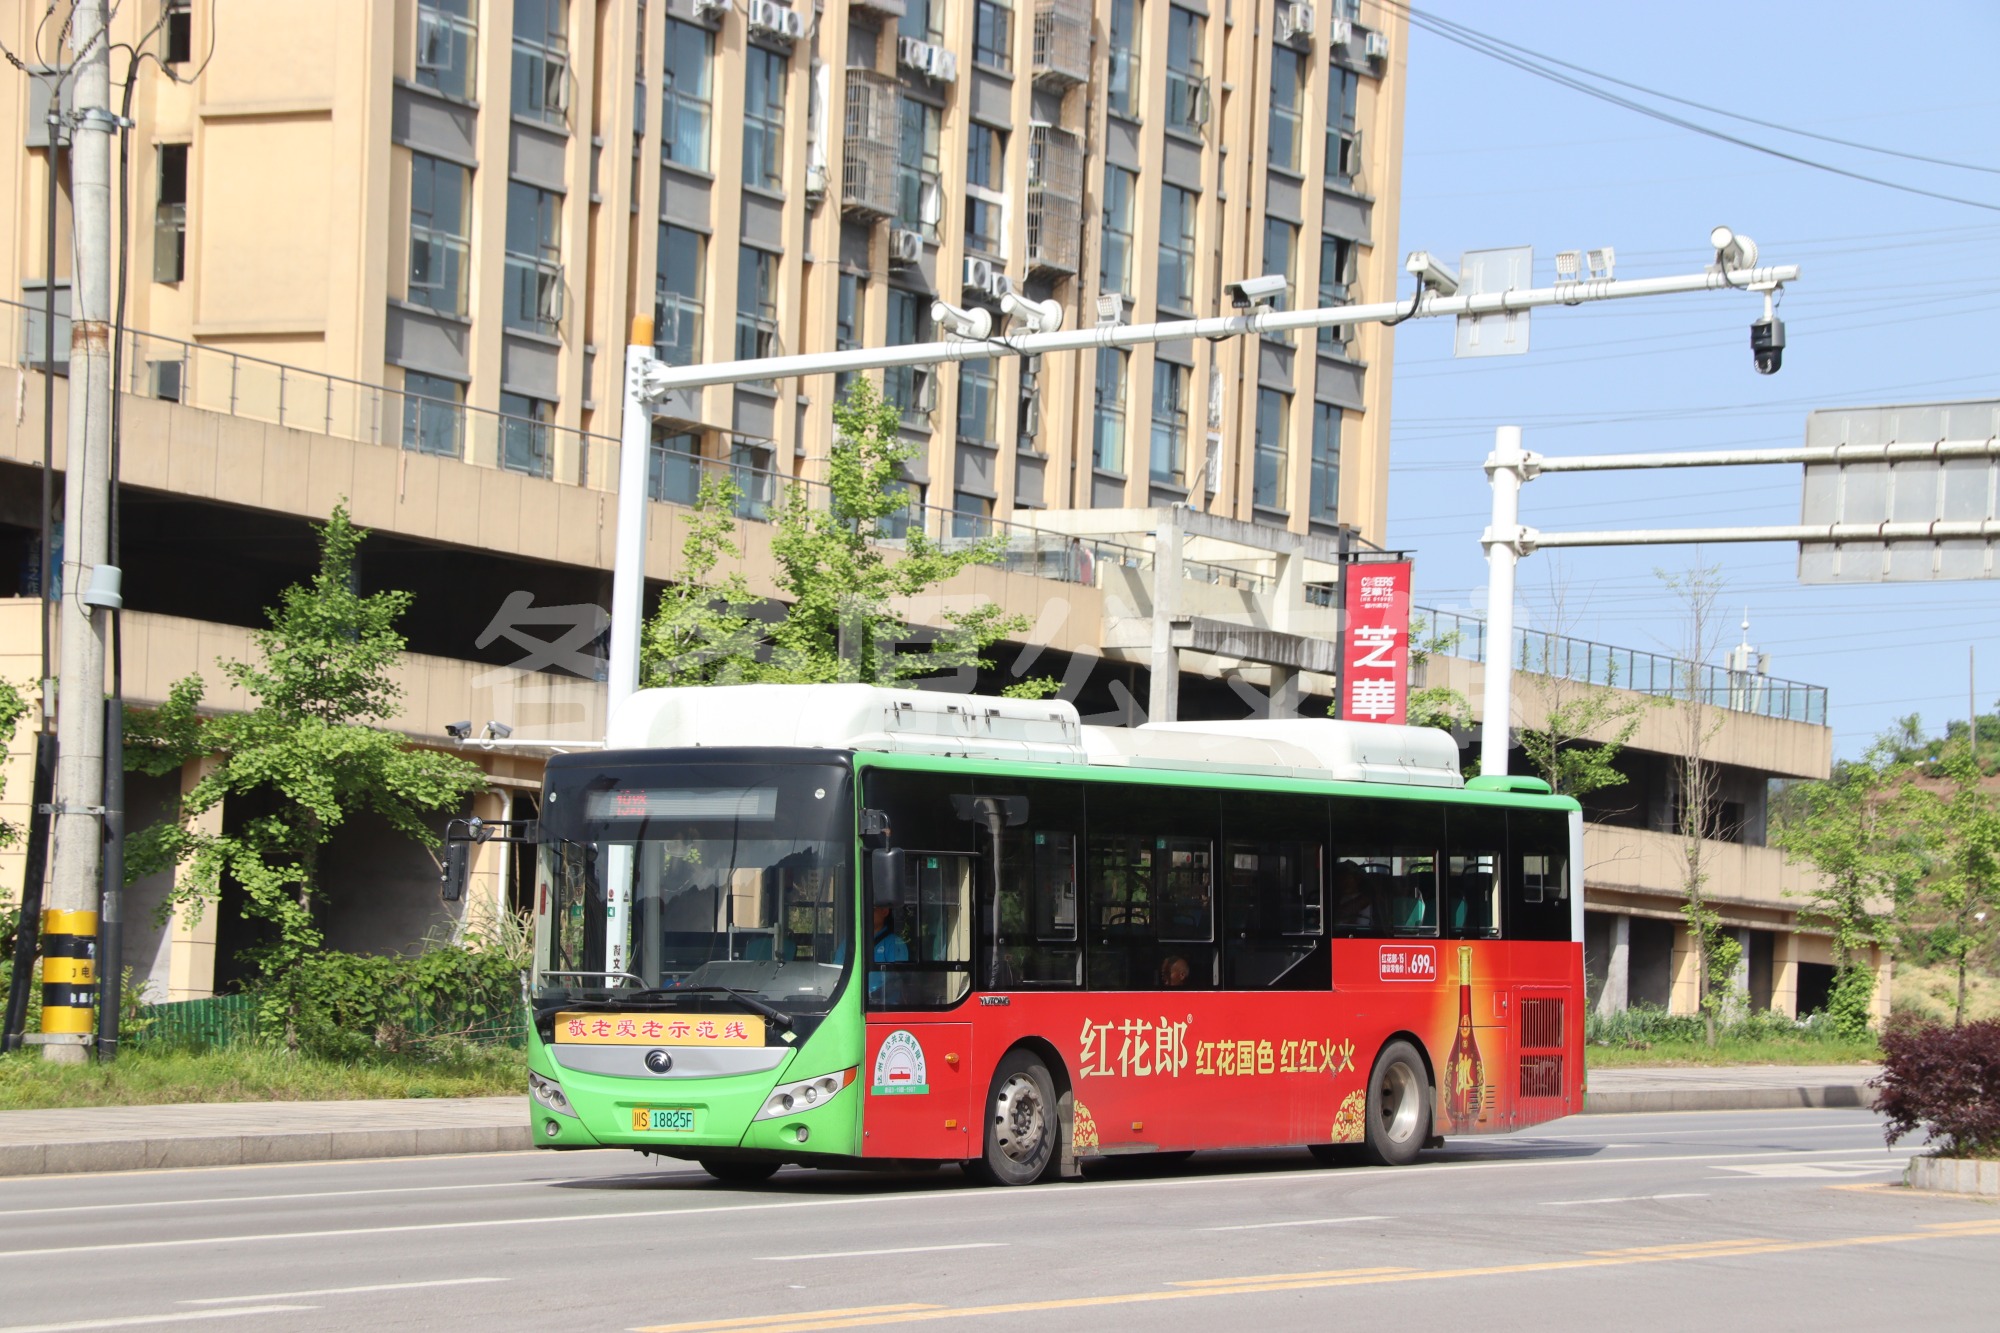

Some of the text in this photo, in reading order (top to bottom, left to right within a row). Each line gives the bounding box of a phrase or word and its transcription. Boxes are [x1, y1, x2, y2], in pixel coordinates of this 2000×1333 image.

[1351, 624, 1398, 720] 芝華
[979, 995, 1010, 1006] YUTONG
[568, 1019, 749, 1040] 敬老爱老示范线
[1079, 1015, 1188, 1079] 红花郎
[1195, 1038, 1356, 1076] 红花国色 红红火火
